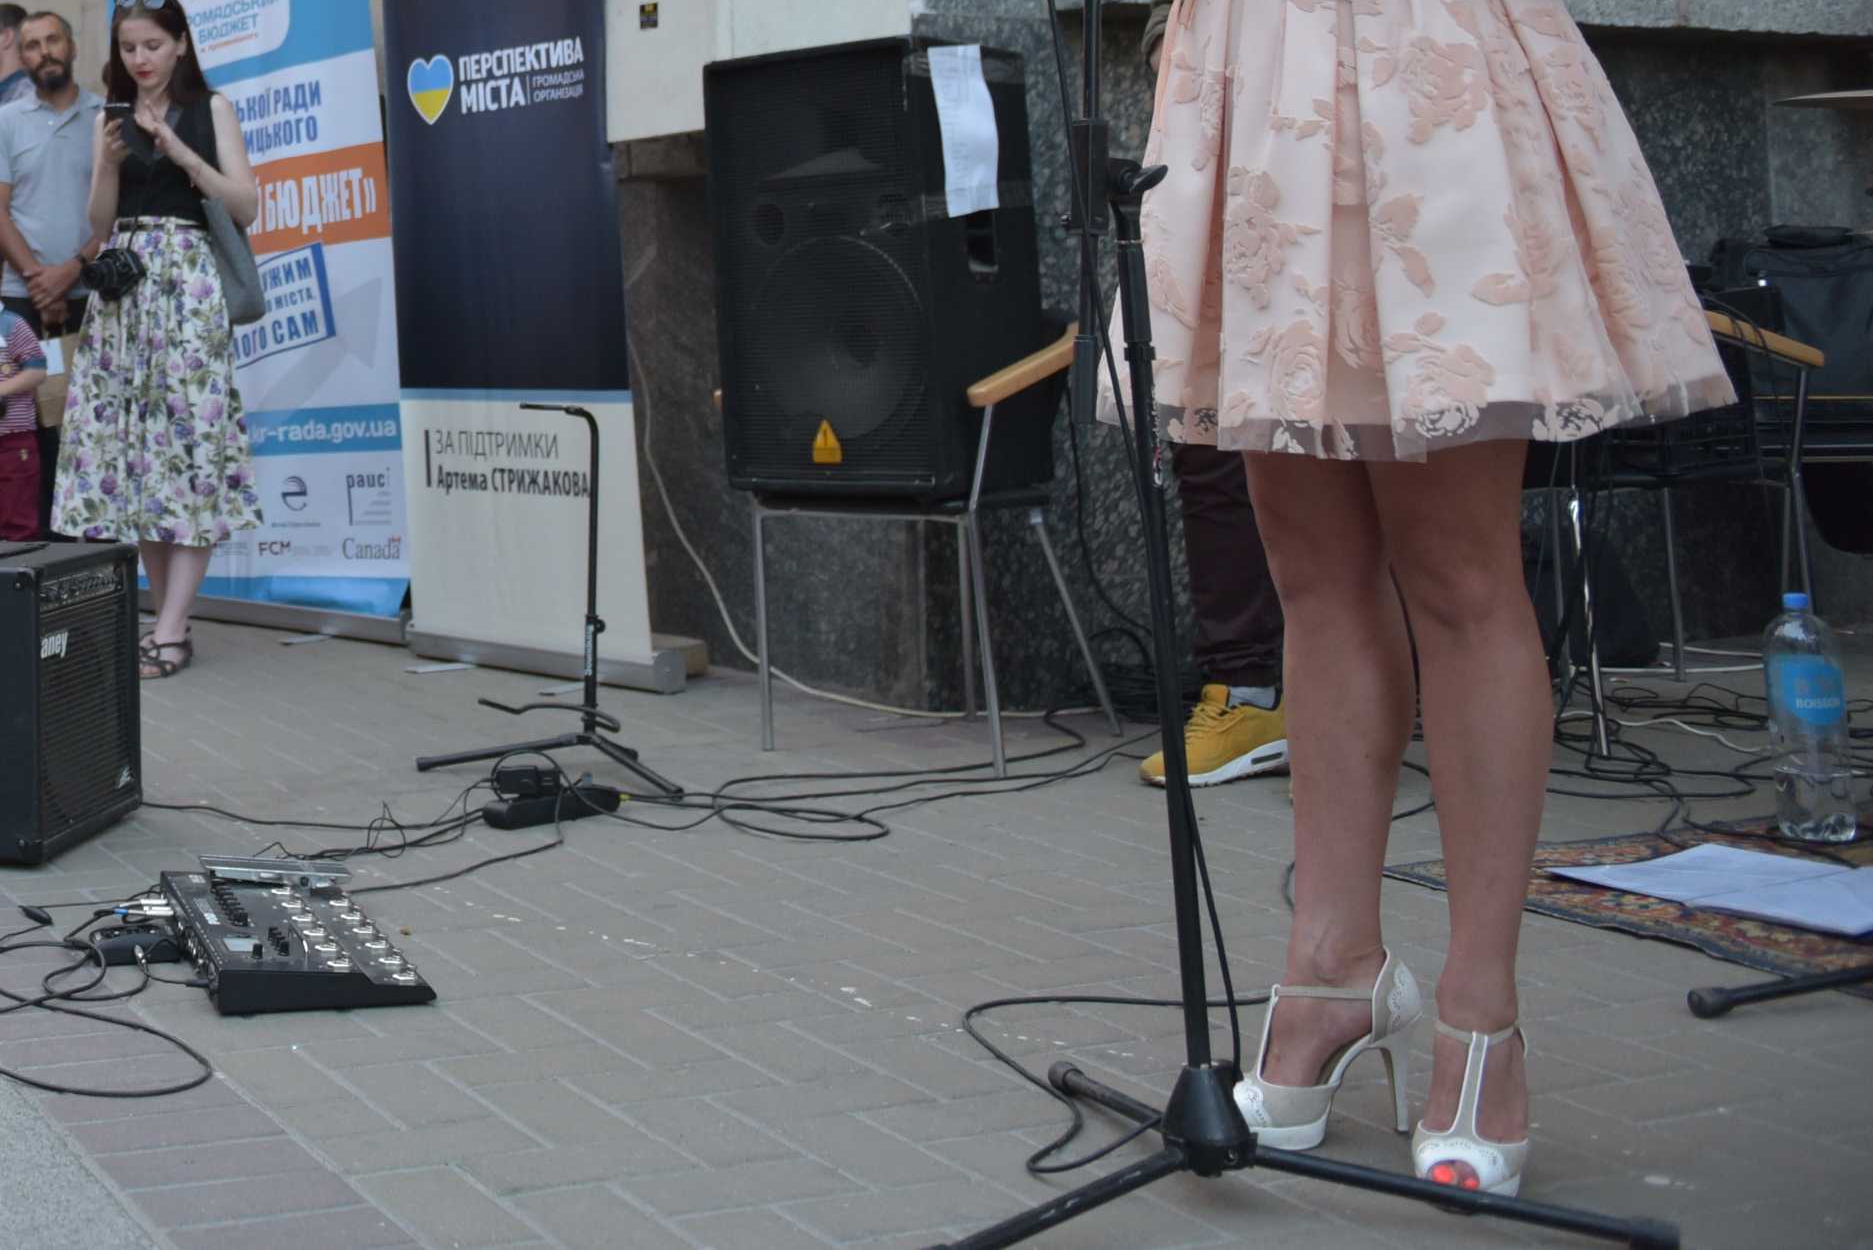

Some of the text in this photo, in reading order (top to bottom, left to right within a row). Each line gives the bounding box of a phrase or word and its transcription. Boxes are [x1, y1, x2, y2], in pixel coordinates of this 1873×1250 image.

[198, 13, 259, 45] БЮДЖЕТ
[458, 35, 585, 82] ПЕРСПЕКТИВА
[234, 80, 322, 123] ЬКОЇ РАДИ
[459, 76, 526, 115] МІСТА
[243, 115, 319, 156] ИЦЬКОГО
[264, 166, 377, 235] БЮДЖЕТ»
[261, 256, 313, 293] УЖИМ
[232, 309, 320, 361] ОГО САМ
[435, 429, 560, 460] ЗА ПІДТРИМКИ
[437, 464, 591, 498] Артема СТРИЖАКОВА
[258, 540, 291, 557] FCM
[342, 536, 401, 561] Canada
[39, 630, 68, 659] aney
